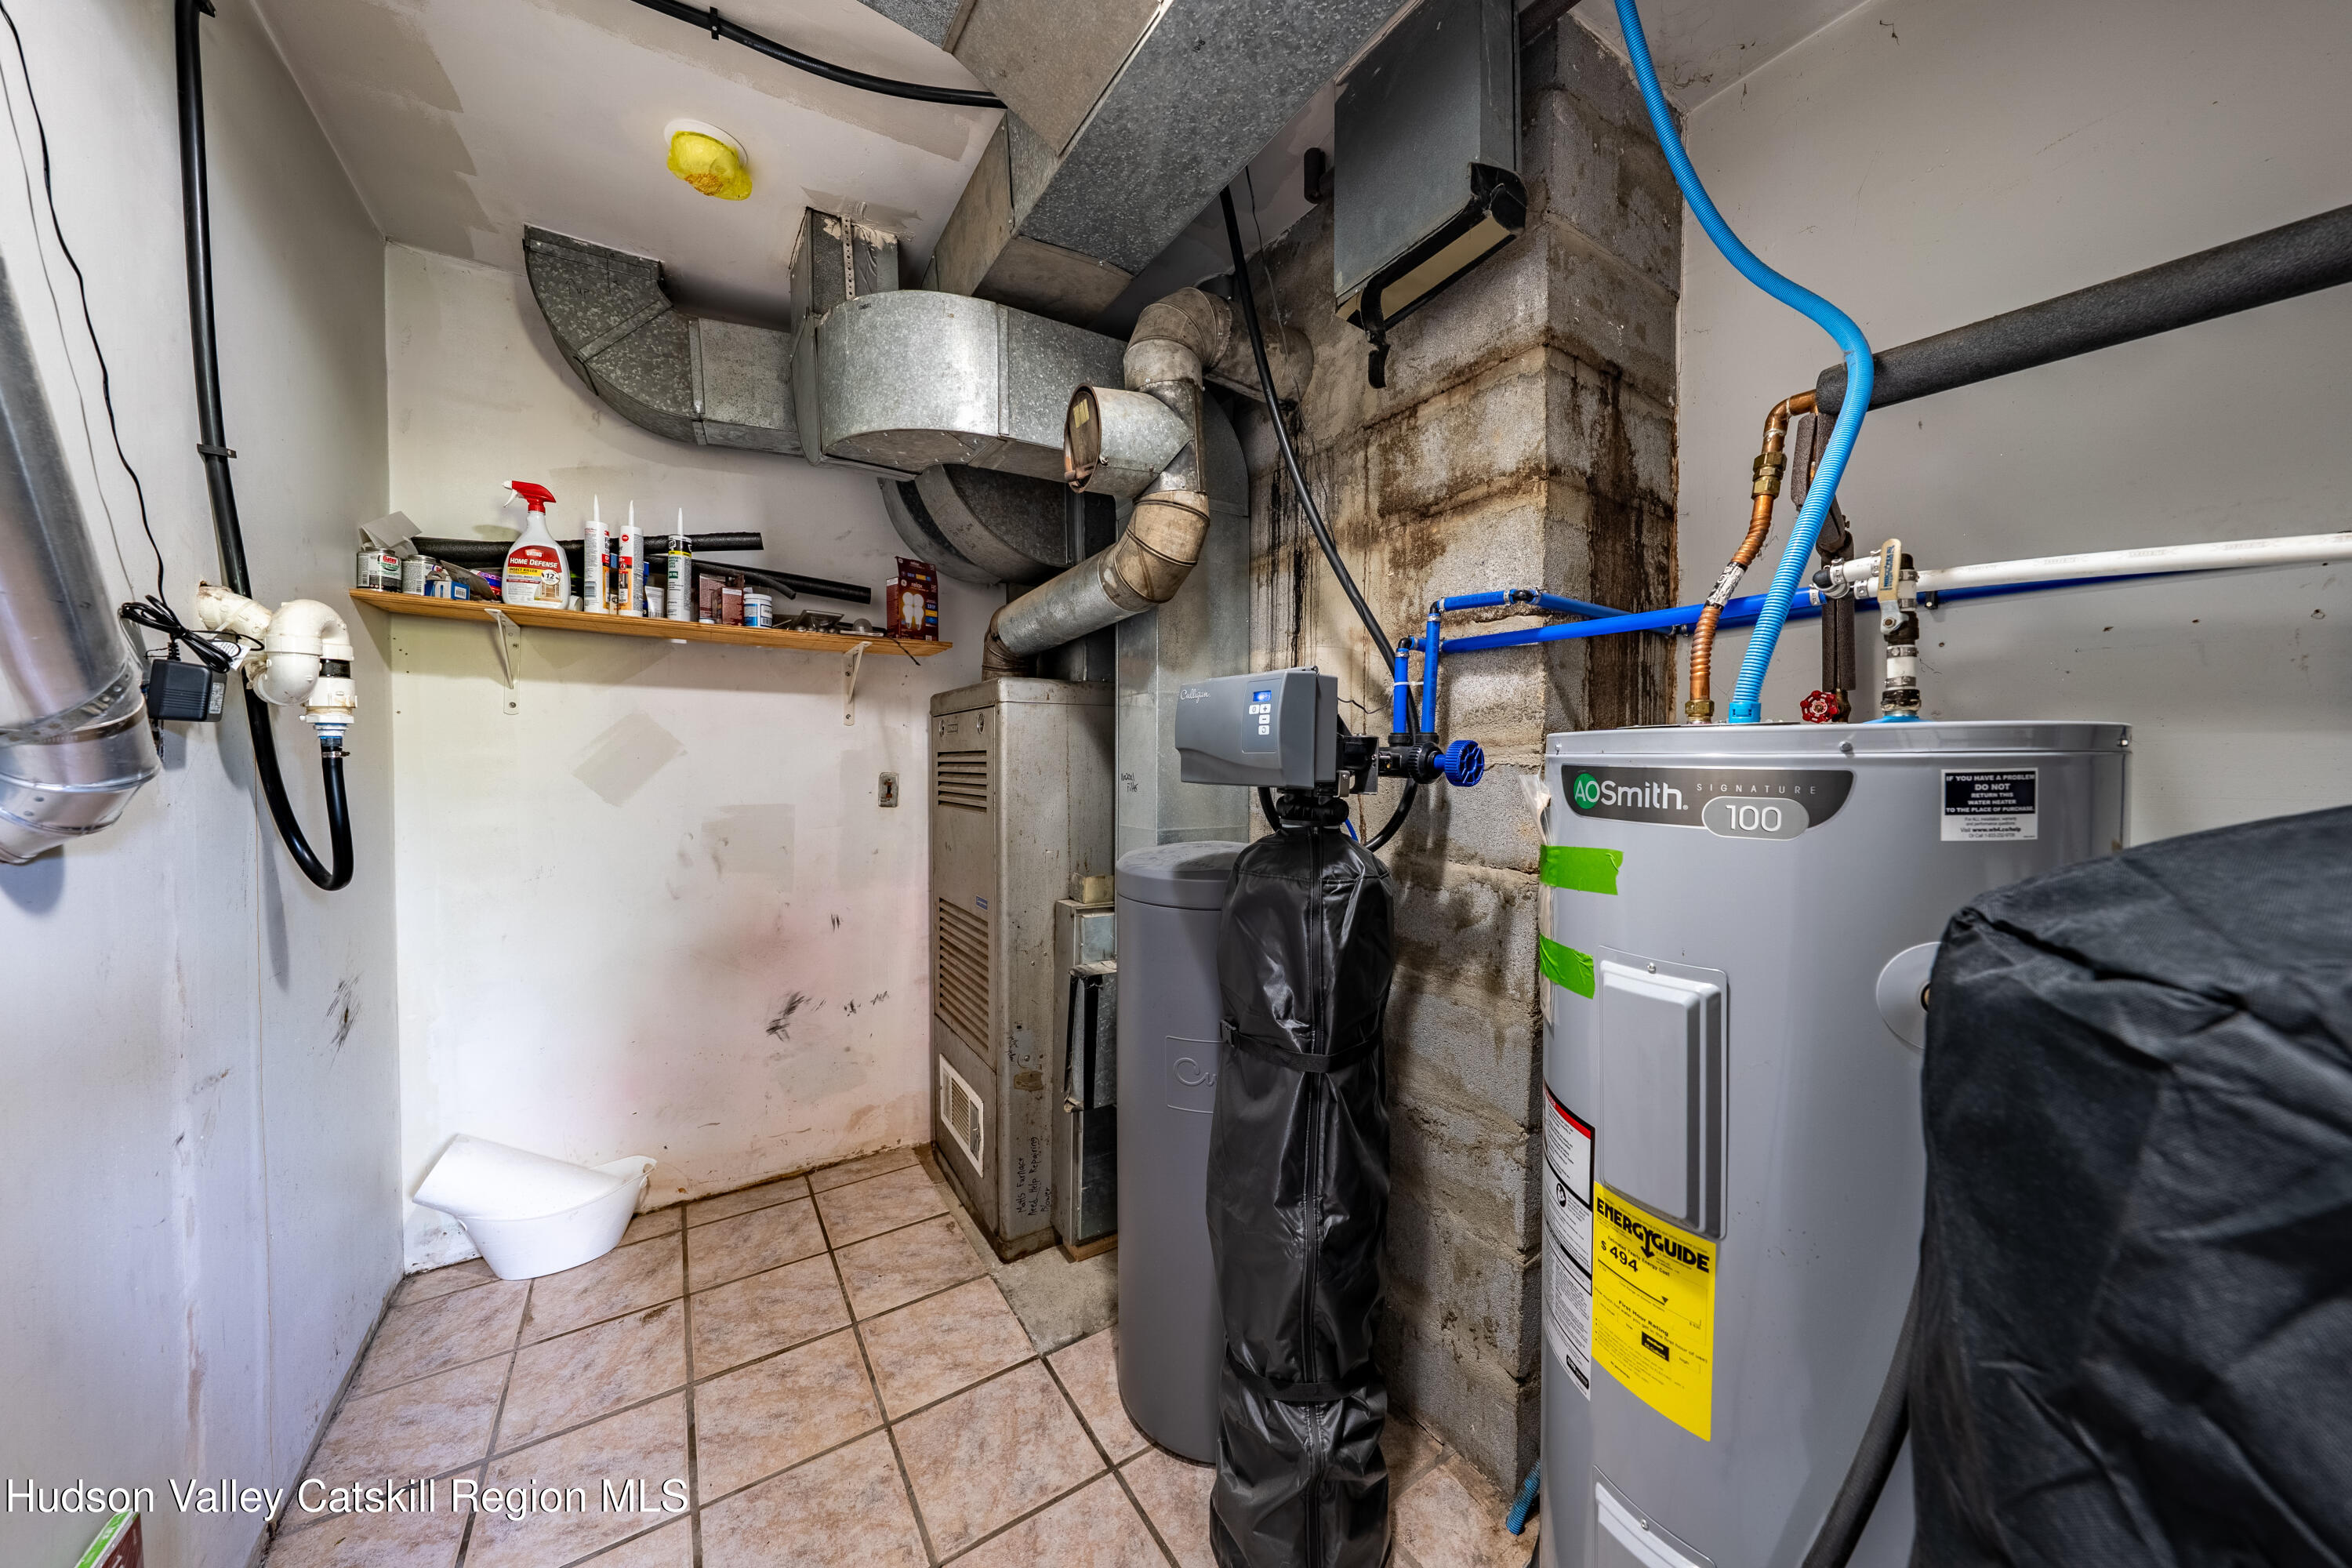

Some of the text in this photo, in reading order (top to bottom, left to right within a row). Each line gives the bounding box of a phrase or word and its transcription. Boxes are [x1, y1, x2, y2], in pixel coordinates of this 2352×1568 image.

[529, 559, 558, 568] DEFENSE
[1697, 783, 1817, 794] SIGNATURE
[1726, 804, 1782, 832] 100
[1028, 1178, 1040, 1193] Help
[1040, 1187, 1051, 1212] Blower
[1596, 1197, 1710, 1274] ENERGYGUIDE
[1601, 1240, 1606, 1251] $
[1610, 1246, 1638, 1272] 494
[1642, 1258, 1657, 1272] Energy
[1659, 1267, 1670, 1277] Cost
[1619, 1300, 1669, 1337] First Hour Rating
[1664, 1336, 1675, 1345] first
